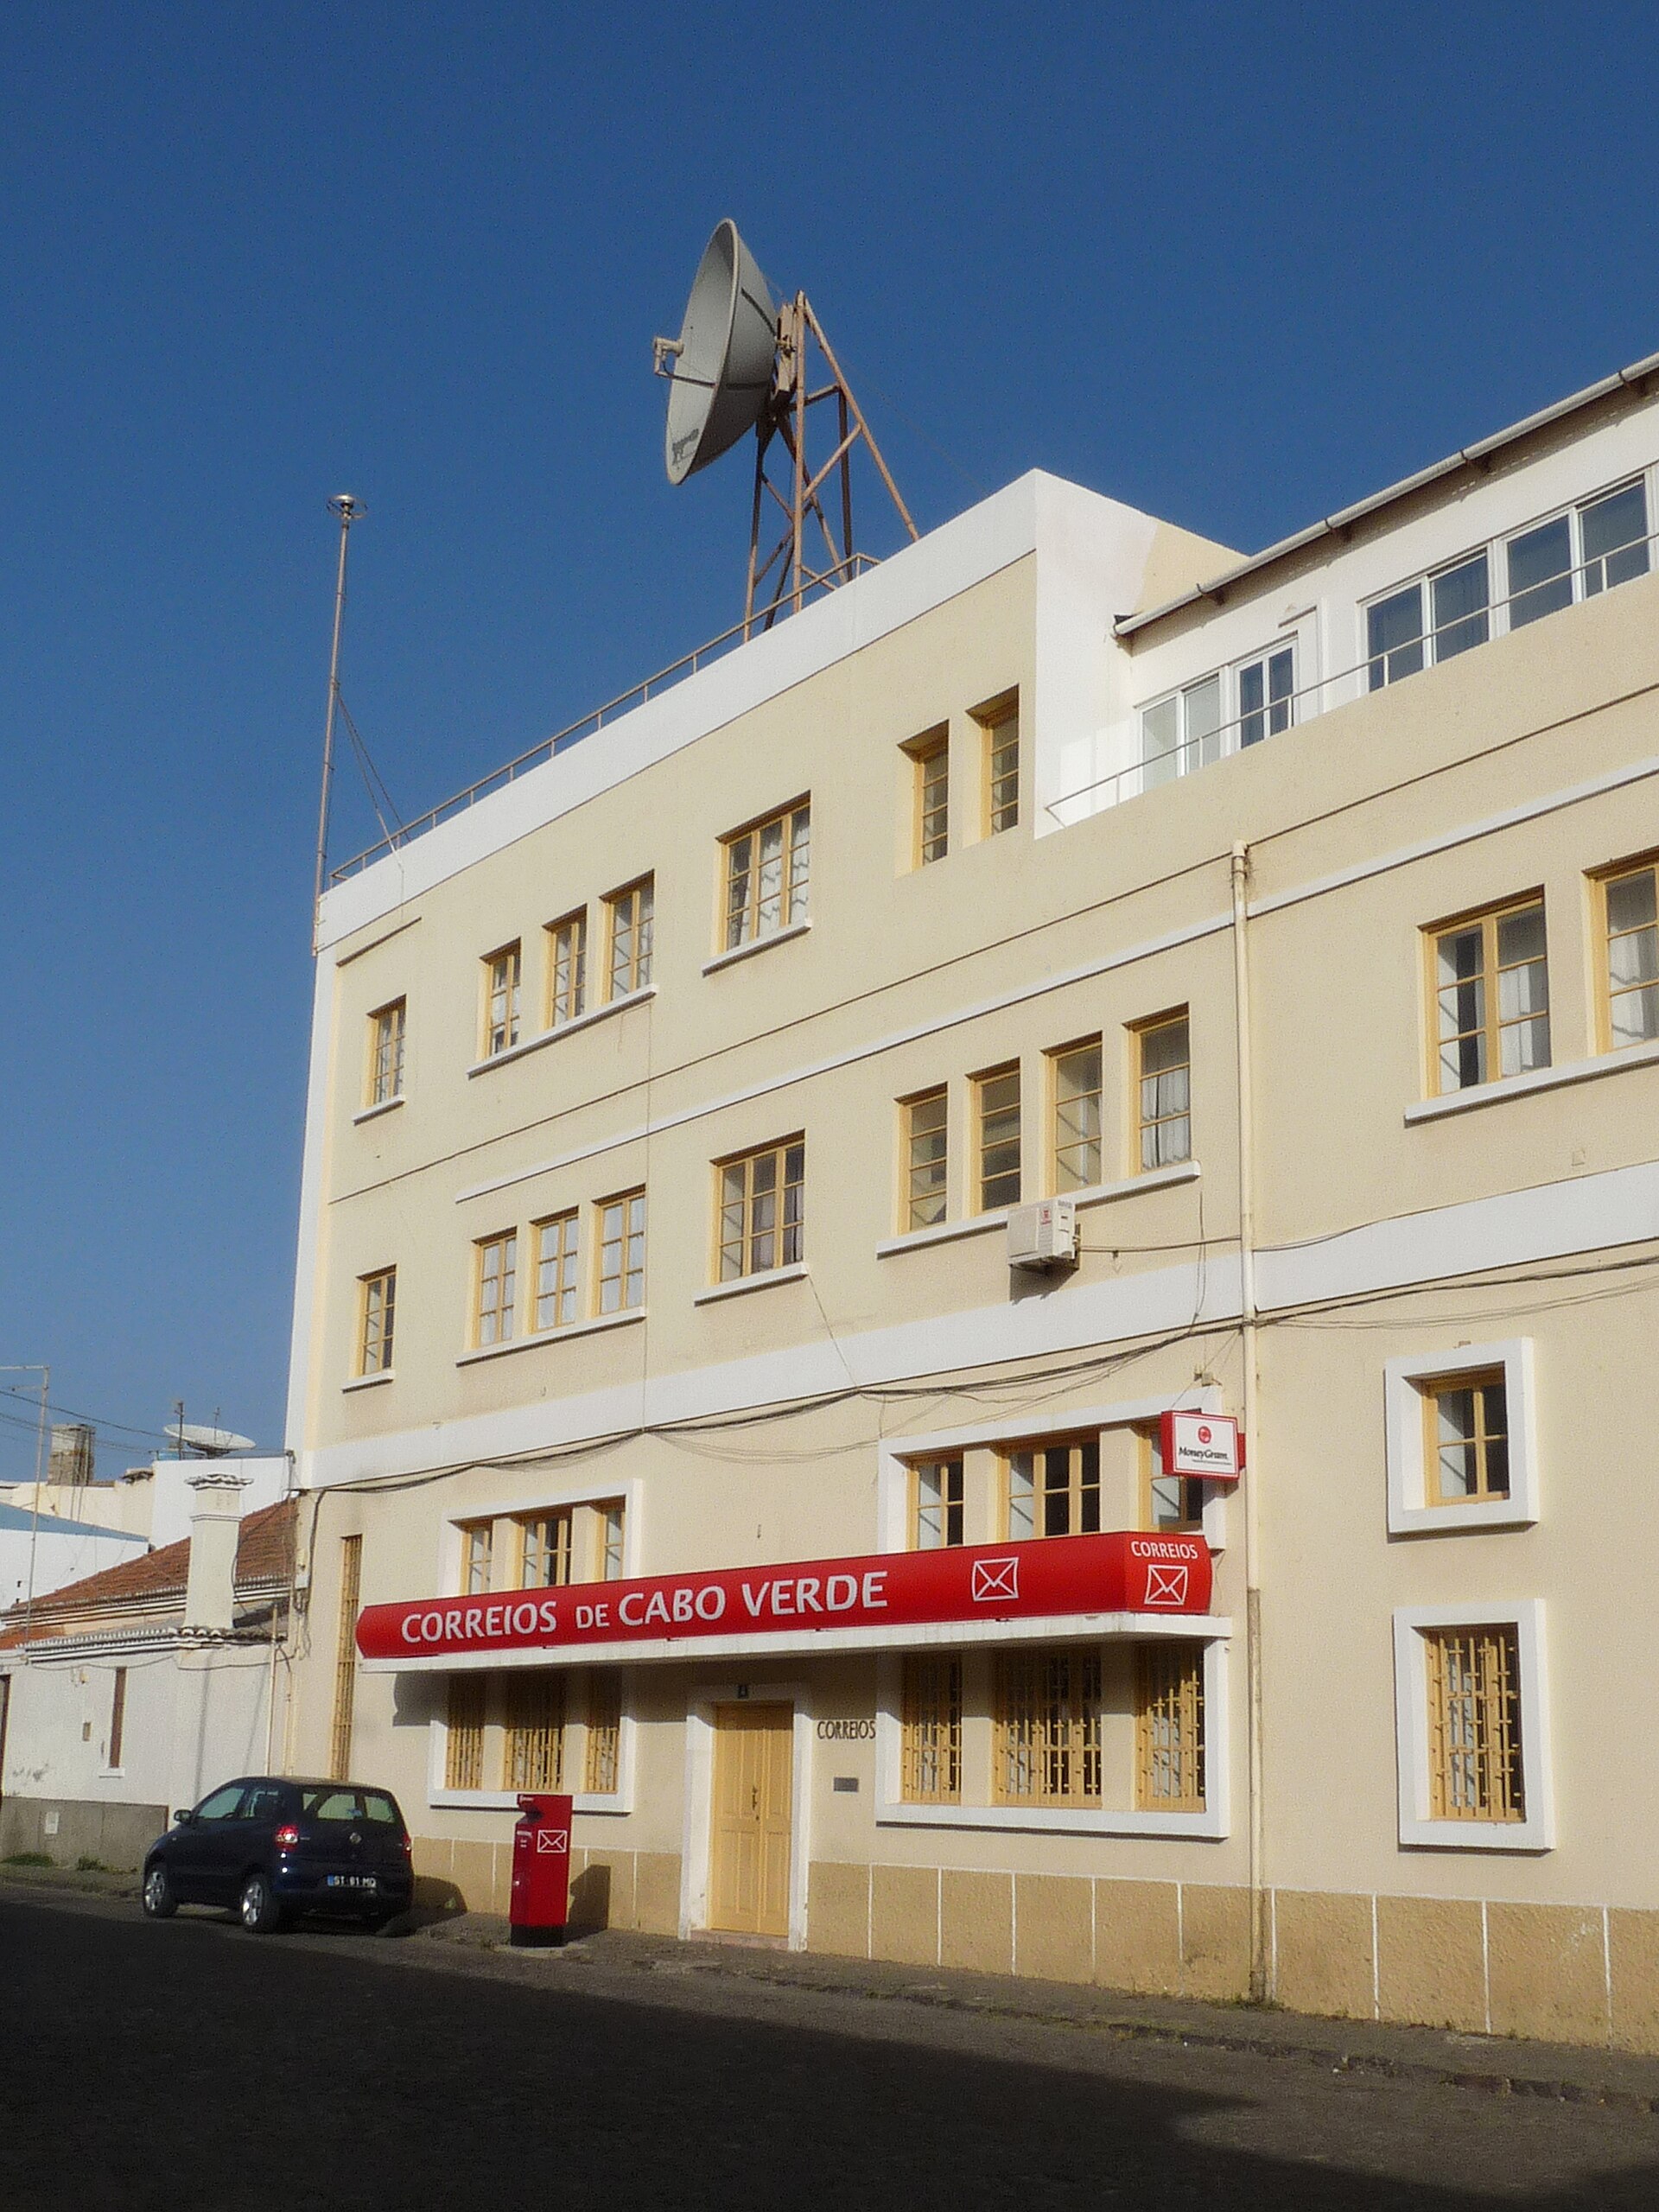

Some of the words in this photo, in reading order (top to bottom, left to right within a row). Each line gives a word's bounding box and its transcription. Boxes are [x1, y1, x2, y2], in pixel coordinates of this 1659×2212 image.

[1179, 1446, 1228, 1459] MoneyGram
[1131, 1541, 1198, 1560] CORREIOS
[401, 1601, 556, 1644] CORREIOS
[575, 1604, 609, 1629] DE
[618, 1586, 726, 1626] CABO
[742, 1571, 888, 1616] VERDE
[817, 1720, 876, 1739] CORREIOS
